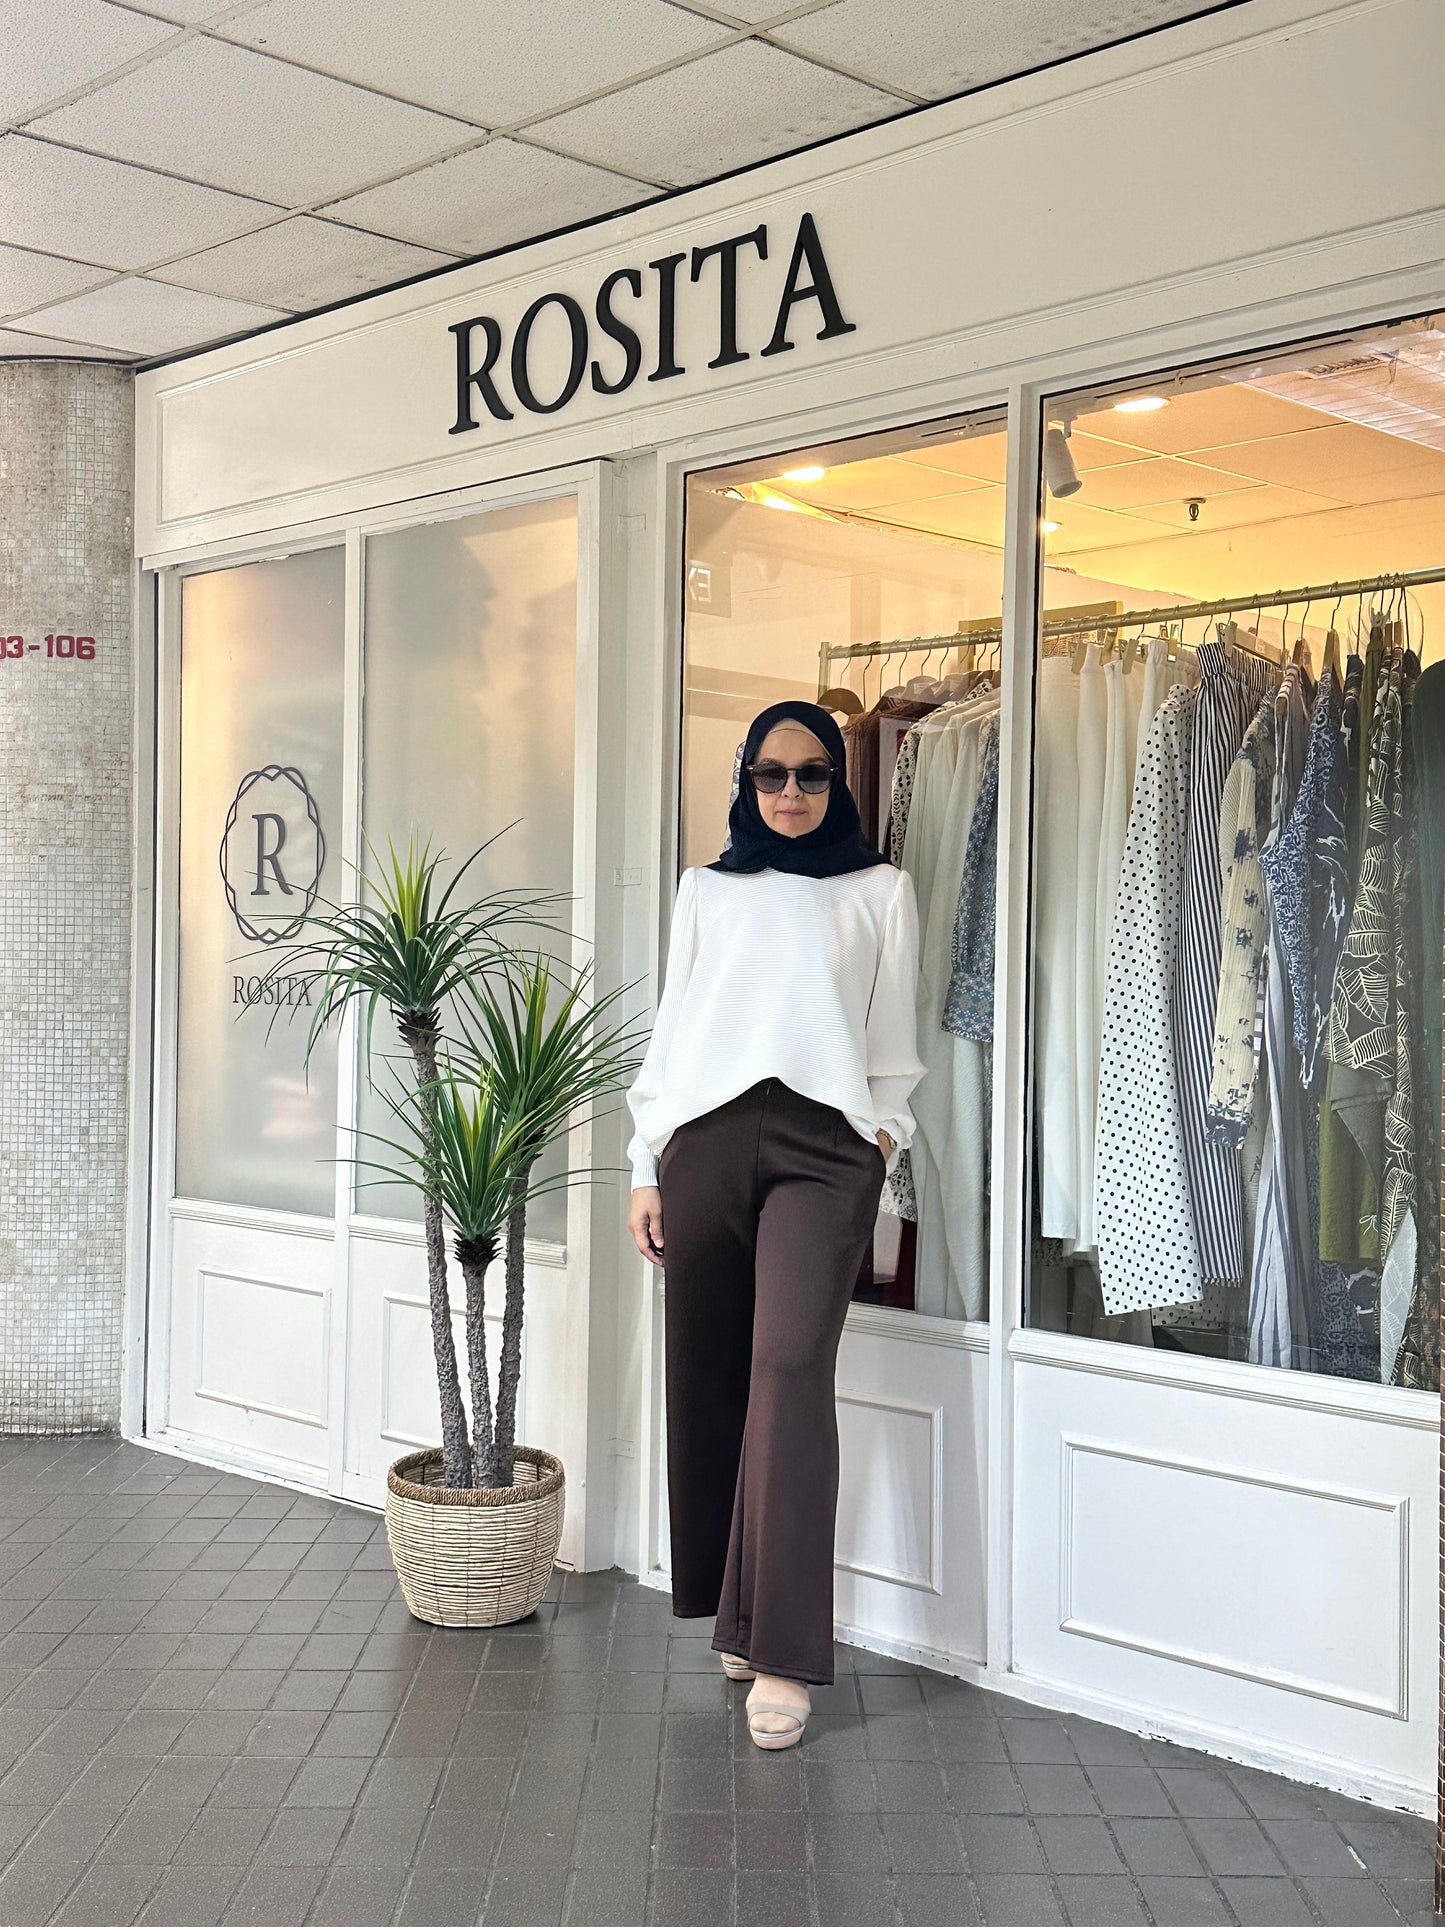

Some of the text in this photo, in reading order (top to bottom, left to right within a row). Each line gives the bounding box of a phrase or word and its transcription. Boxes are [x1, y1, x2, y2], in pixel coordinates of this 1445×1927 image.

[448, 212, 857, 435] ROSITA
[250, 813, 294, 896] R
[232, 975, 313, 1007] ROSITA
